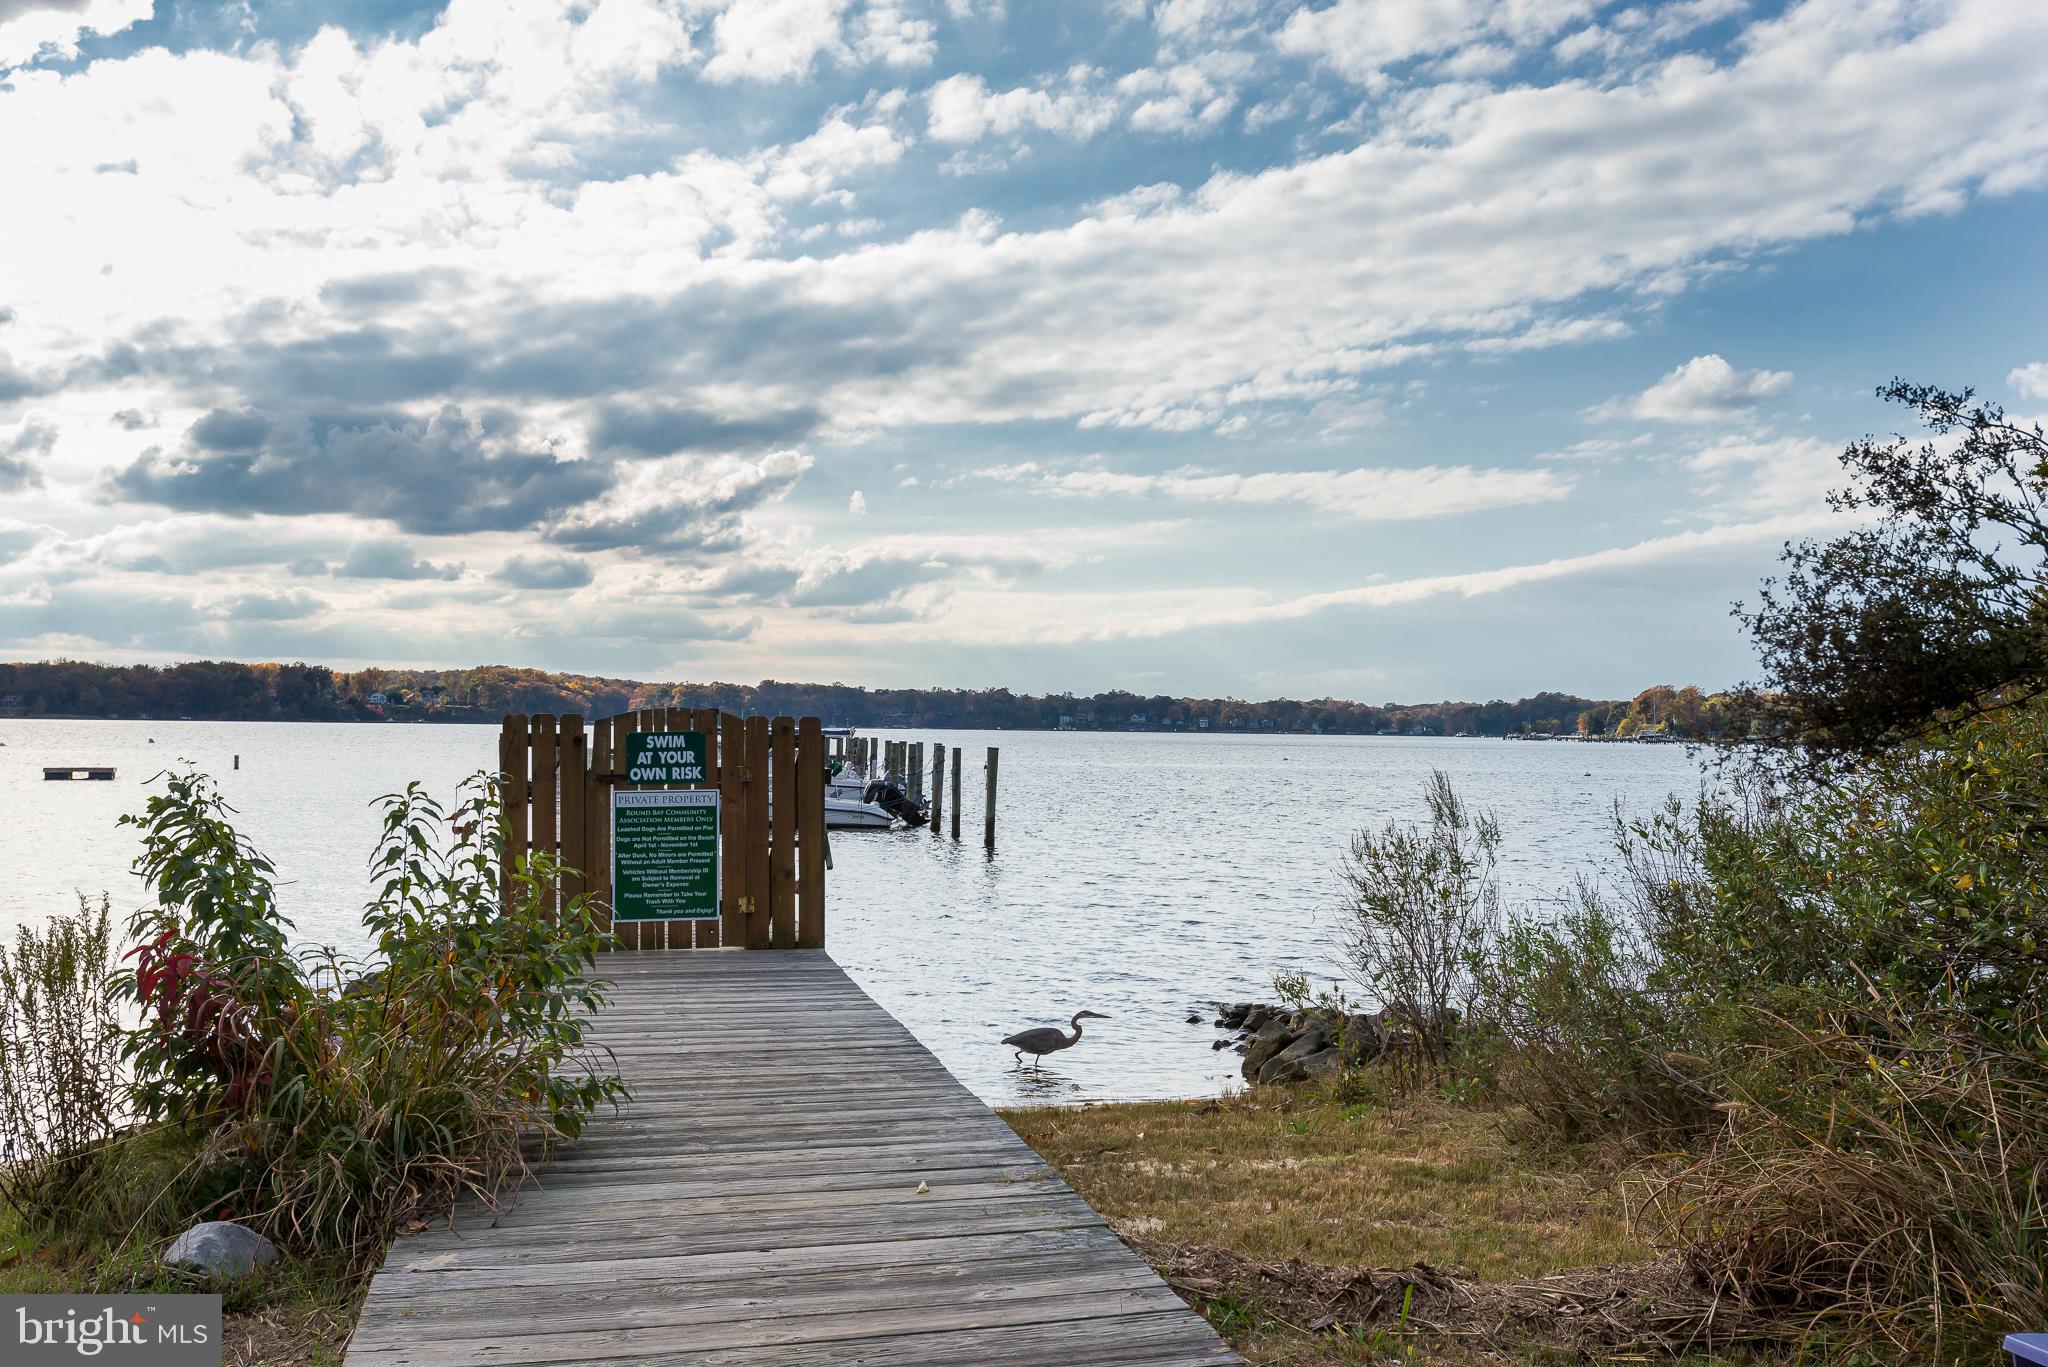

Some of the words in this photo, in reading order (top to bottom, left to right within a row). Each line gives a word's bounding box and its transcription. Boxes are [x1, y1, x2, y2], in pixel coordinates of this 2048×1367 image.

[646, 736, 685, 748] SWIM
[637, 752, 654, 764] AT
[658, 751, 695, 763] YOUR
[630, 768, 666, 780] OWN
[672, 767, 702, 779] RISK
[662, 795, 713, 803] PROPERTY
